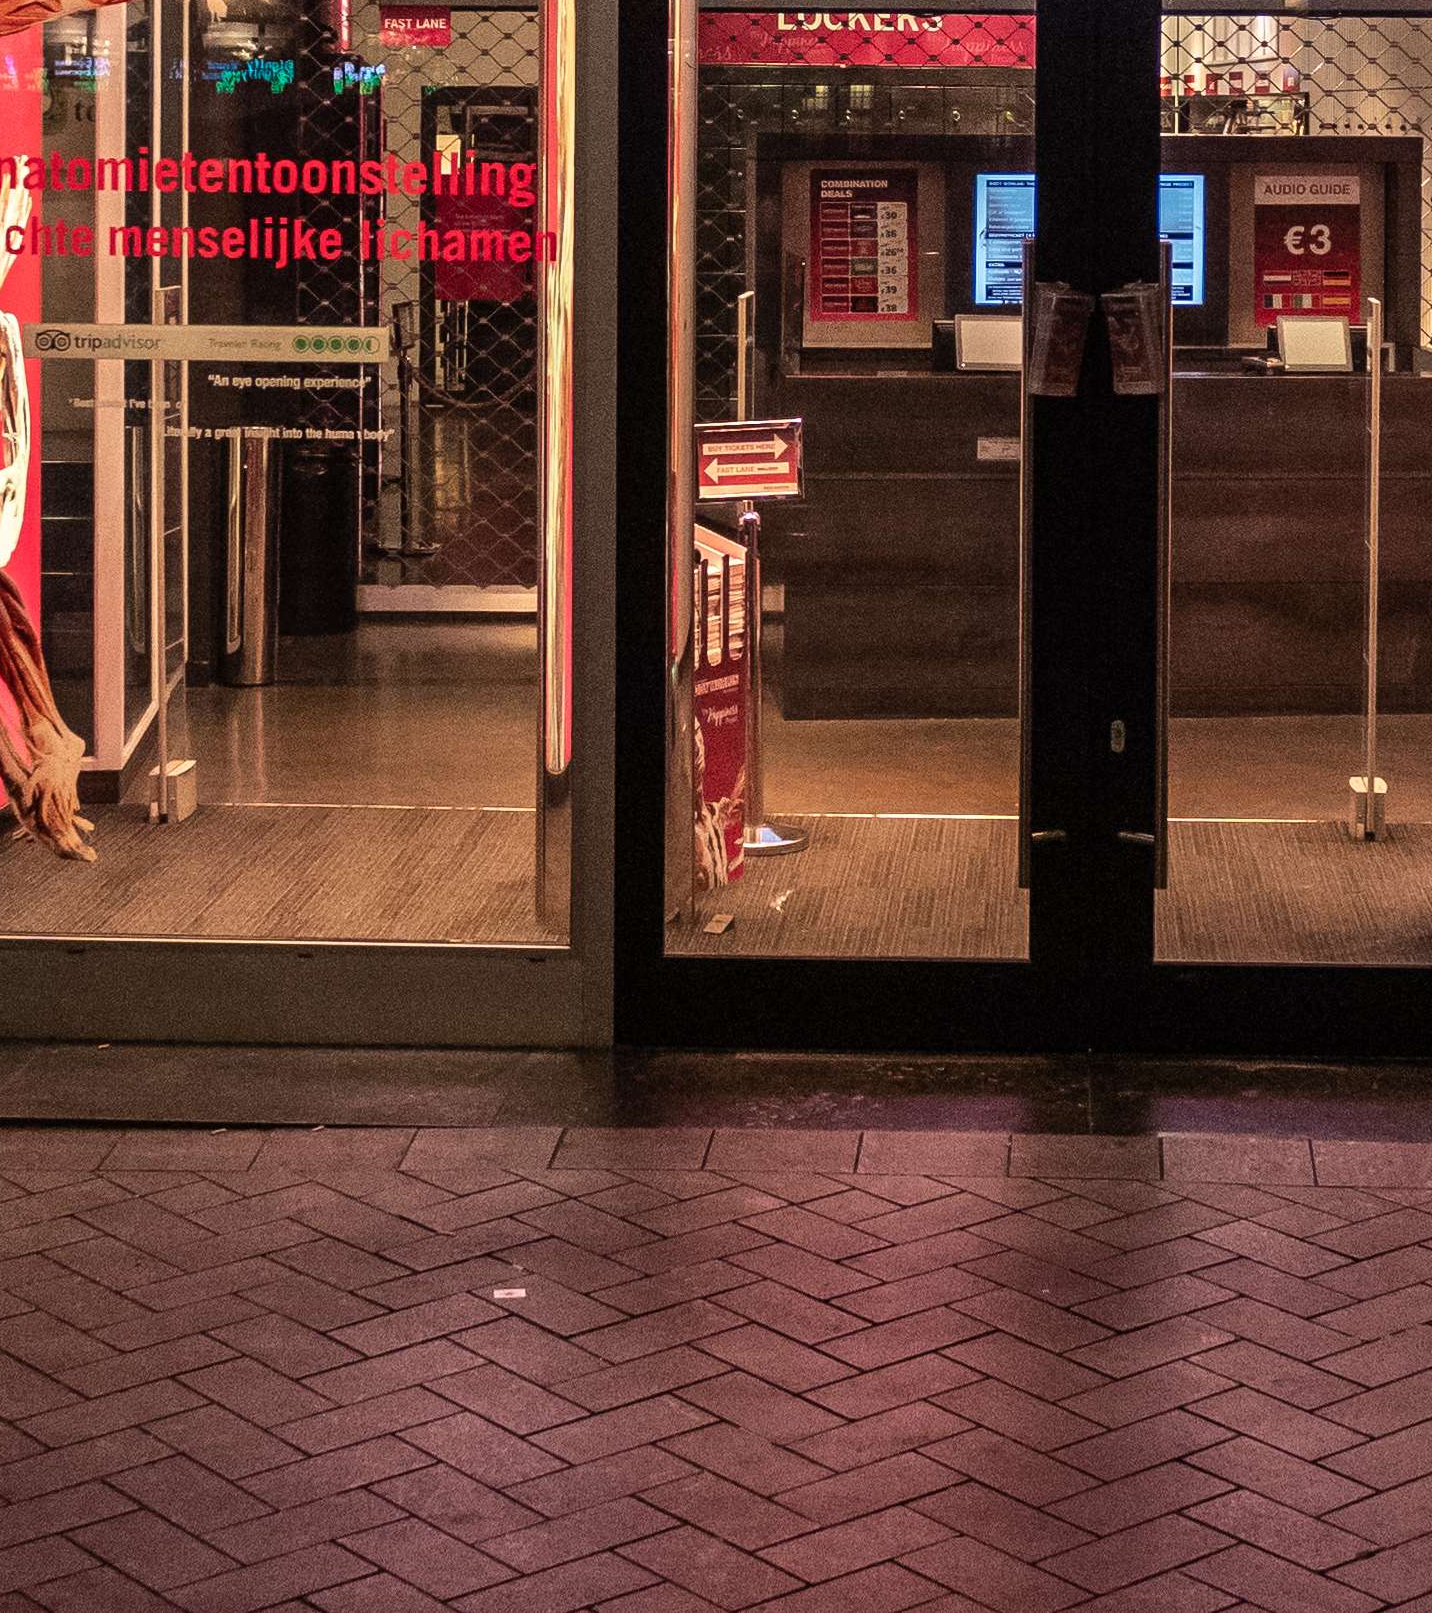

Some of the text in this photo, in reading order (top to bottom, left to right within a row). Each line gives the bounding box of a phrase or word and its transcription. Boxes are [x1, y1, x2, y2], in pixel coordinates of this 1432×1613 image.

[384, 19, 447, 29] FAST LANE
[820, 180, 888, 188] COMBINATION
[820, 190, 853, 198] DEALS
[1264, 185, 1351, 197] AUDIO GUIDE
[109, 217, 344, 269] menselijke
[363, 219, 557, 263] lichamen
[1283, 224, 1332, 256] €3
[74, 335, 162, 352] tripadvisor
[255, 375, 301, 390] opening
[282, 427, 303, 439] into
[306, 427, 322, 439] the
